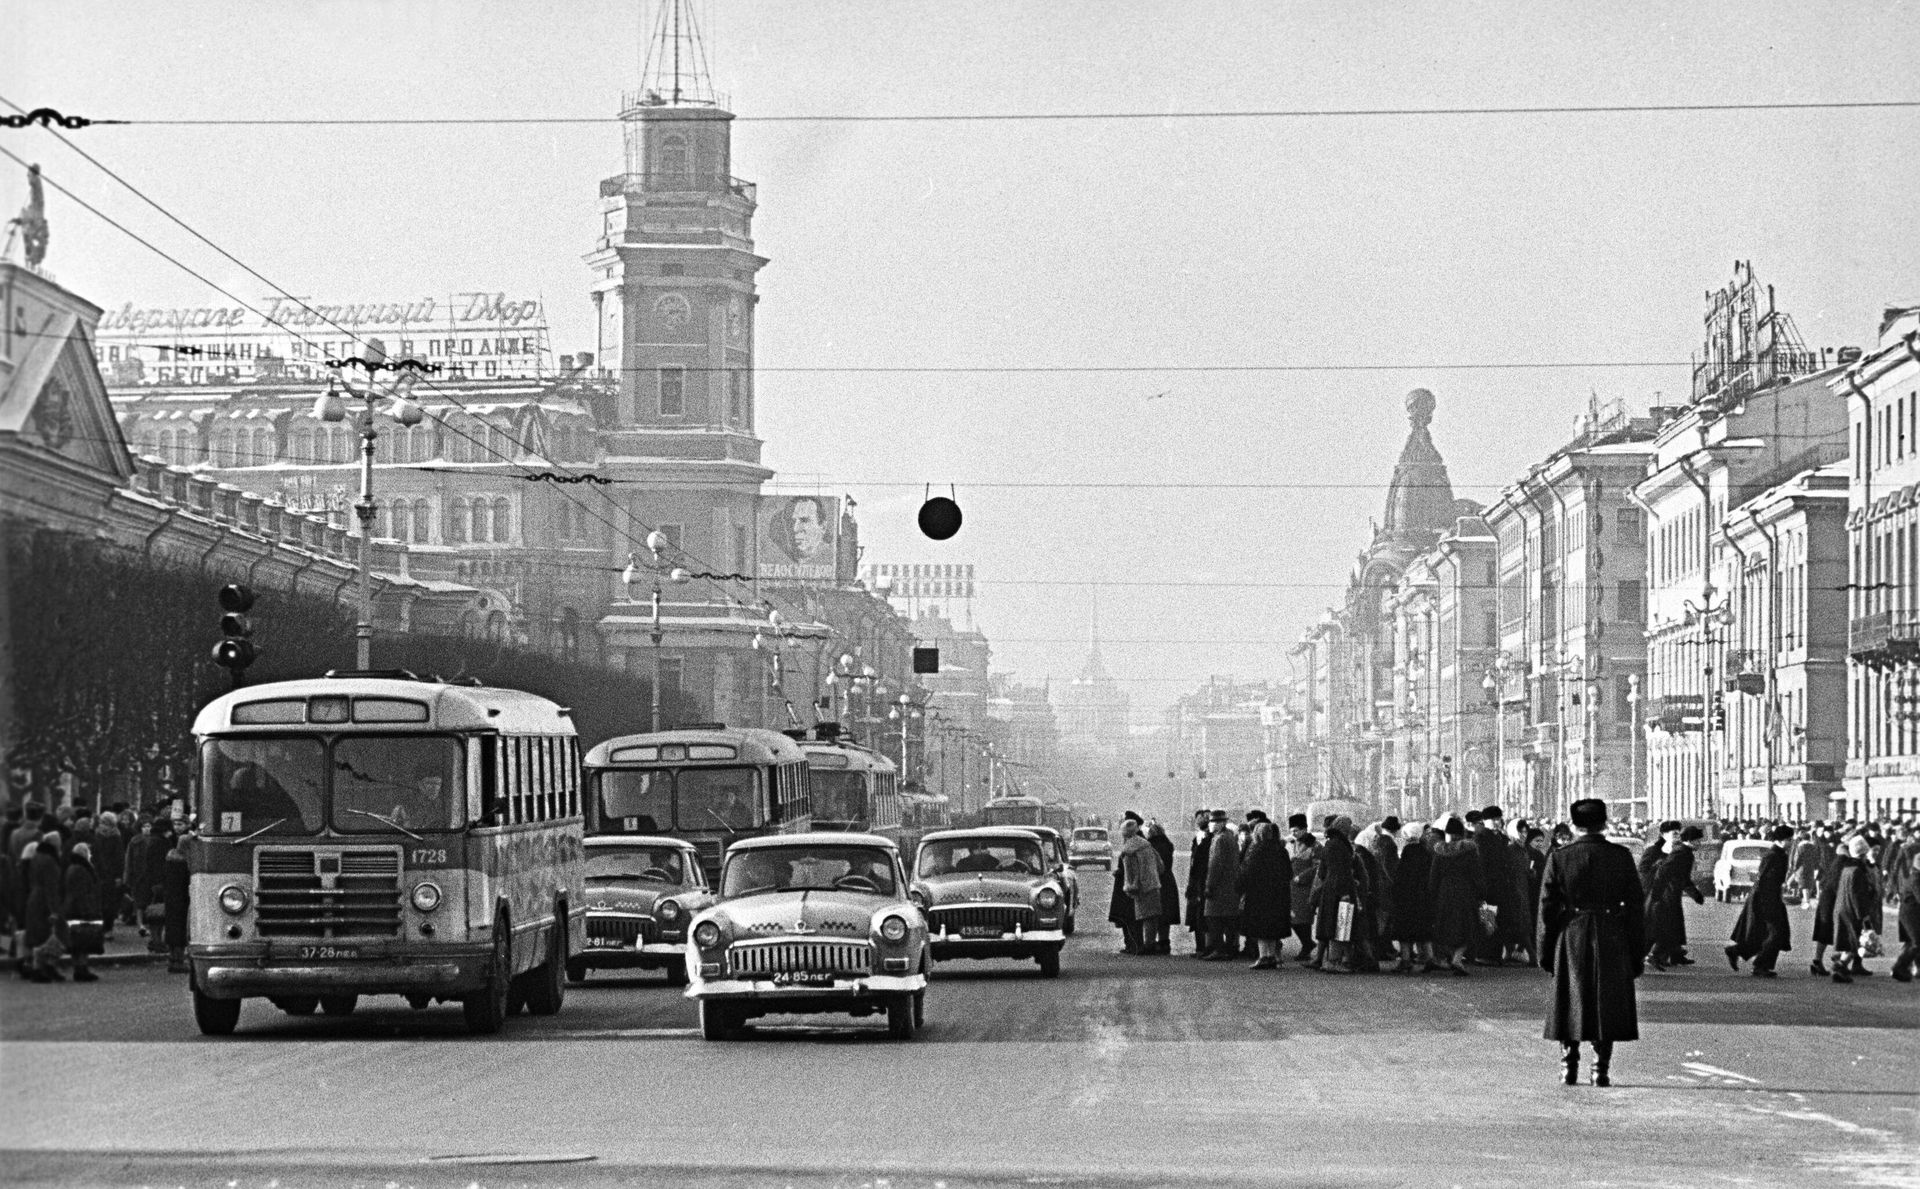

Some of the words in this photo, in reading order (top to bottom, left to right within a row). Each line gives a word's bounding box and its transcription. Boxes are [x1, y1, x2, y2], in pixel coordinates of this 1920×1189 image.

[261, 297, 434, 327] Гостиный
[459, 292, 536, 326] Двор
[429, 338, 534, 356] ПРОДАЖЕ
[227, 816, 235, 830] 7
[411, 849, 447, 864] 1728
[773, 970, 808, 984] 24-85
